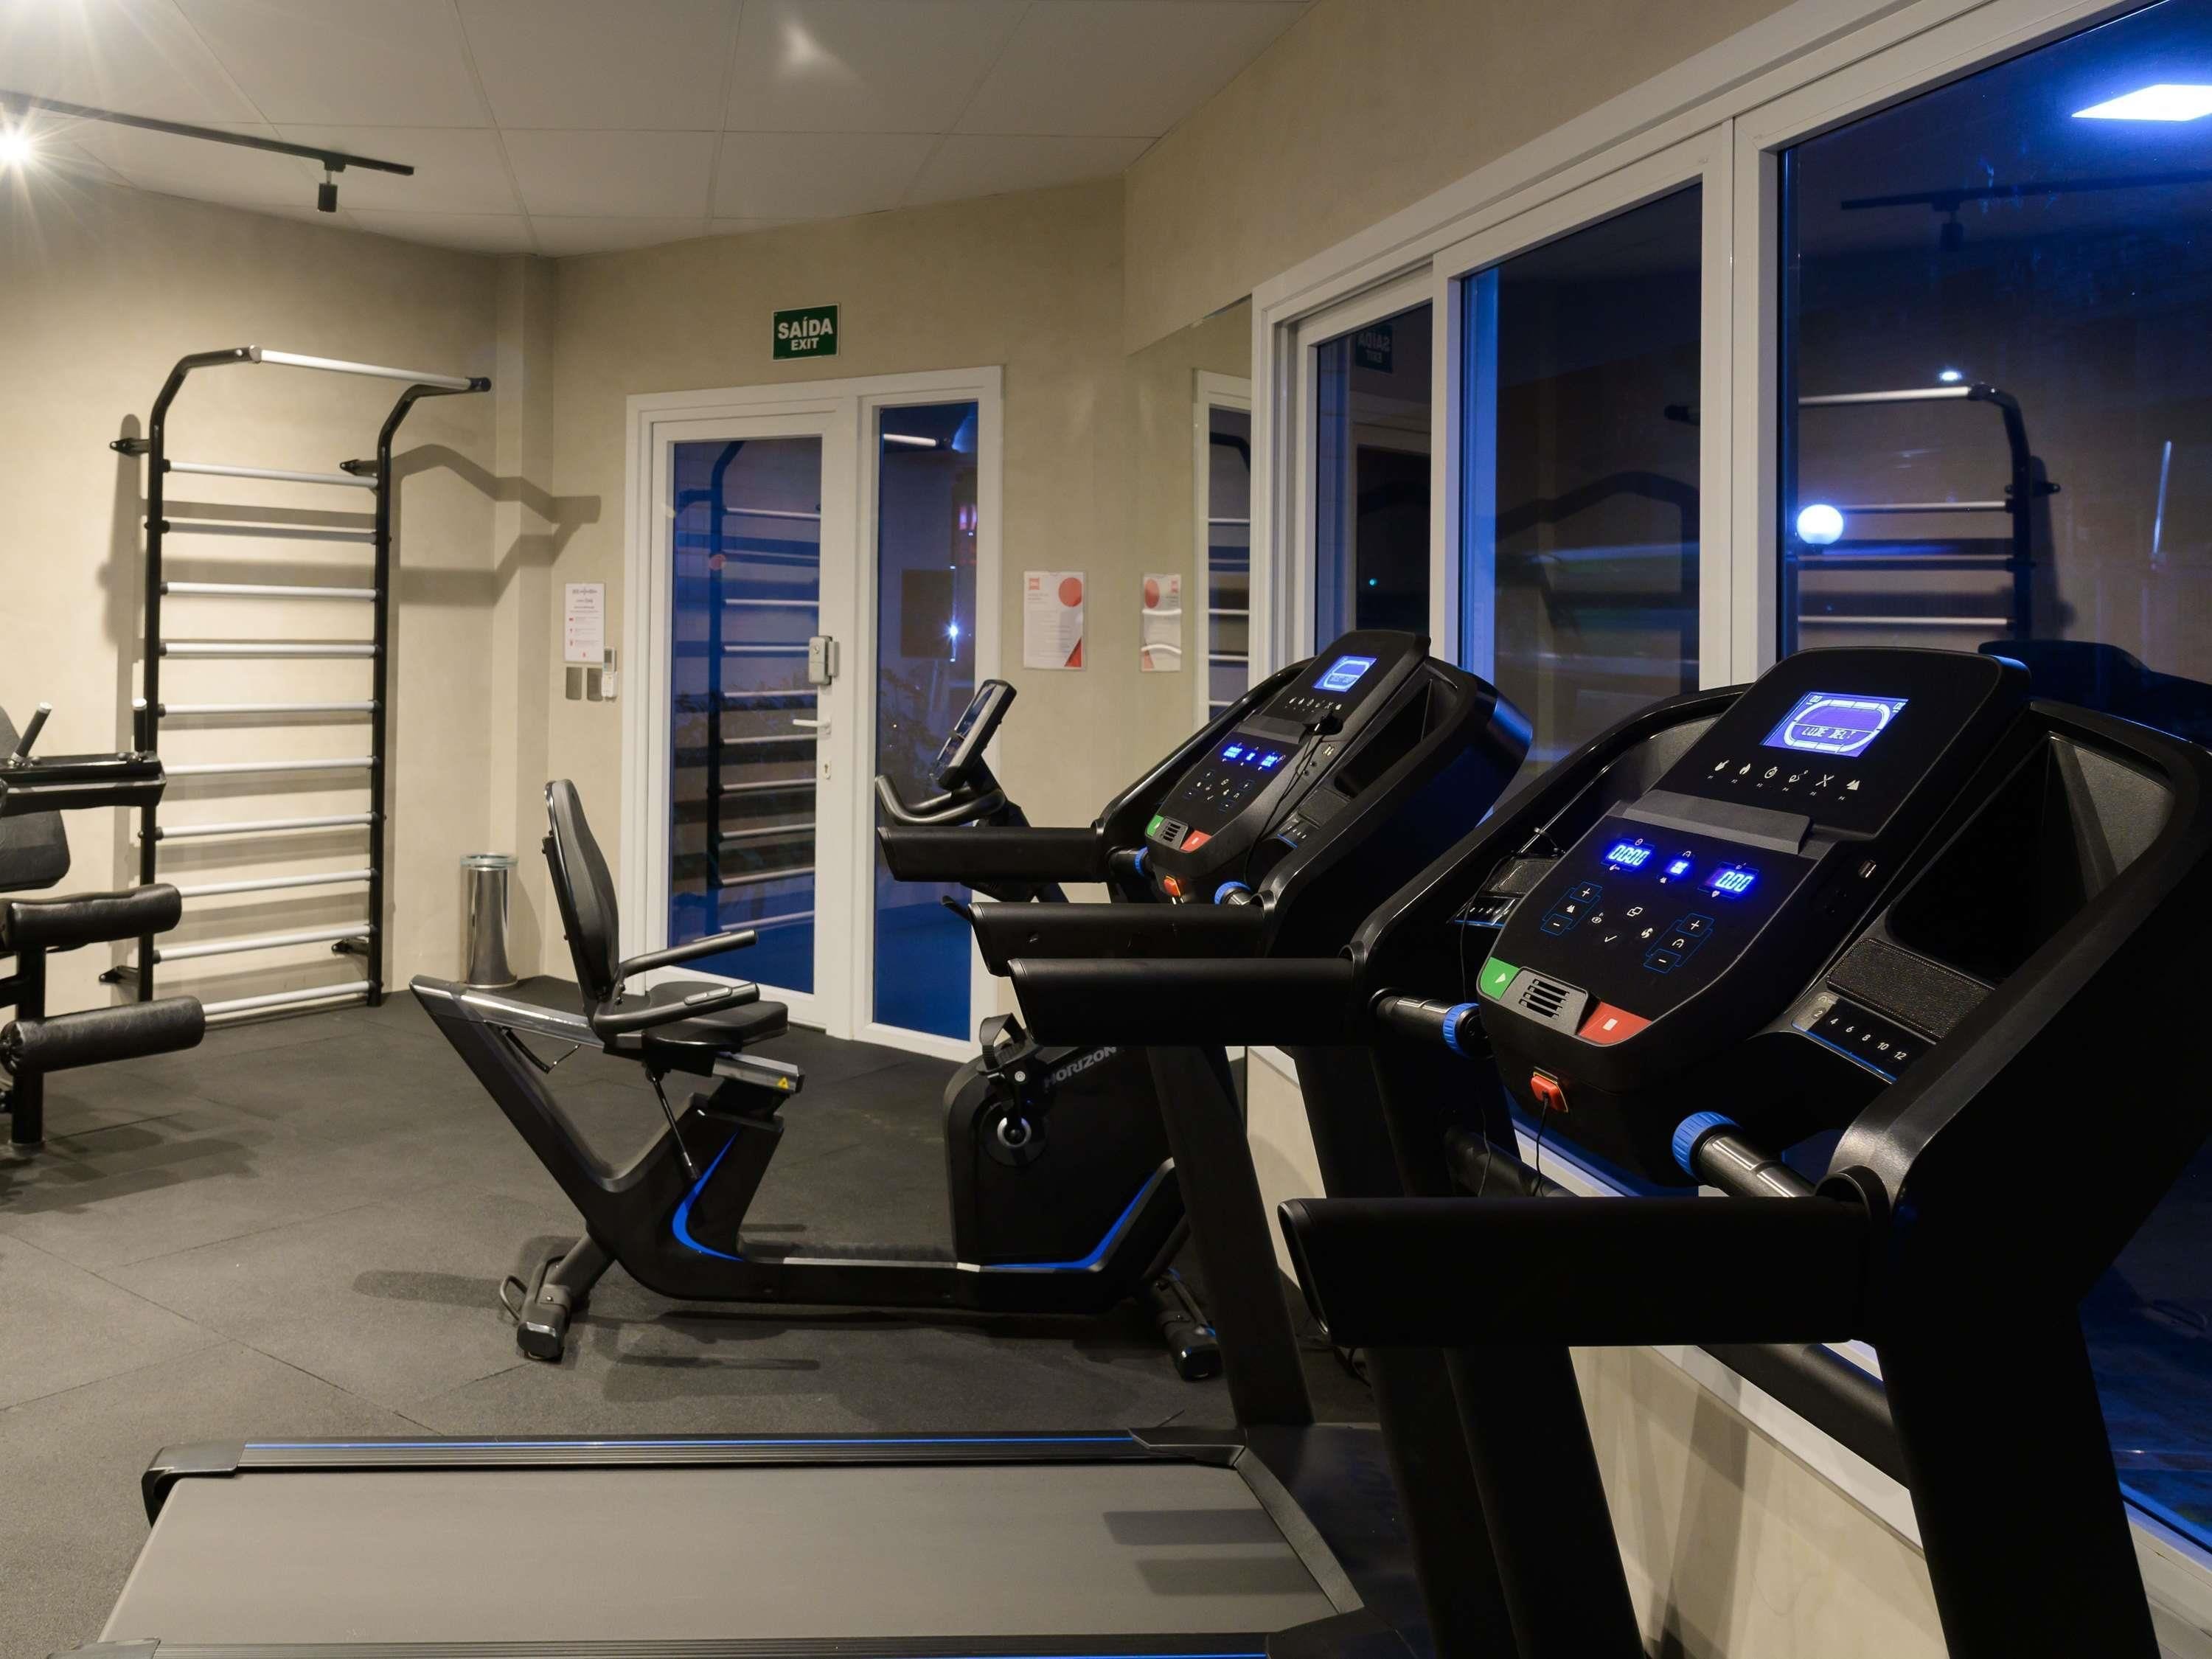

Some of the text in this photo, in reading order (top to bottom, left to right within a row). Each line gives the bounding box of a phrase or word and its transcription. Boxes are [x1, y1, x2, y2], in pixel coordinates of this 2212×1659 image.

[778, 316, 833, 339] SAÍDA
[790, 338, 819, 350] EXIT
[1877, 1042, 1890, 1051] 10
[1893, 1051, 1907, 1060] 12
